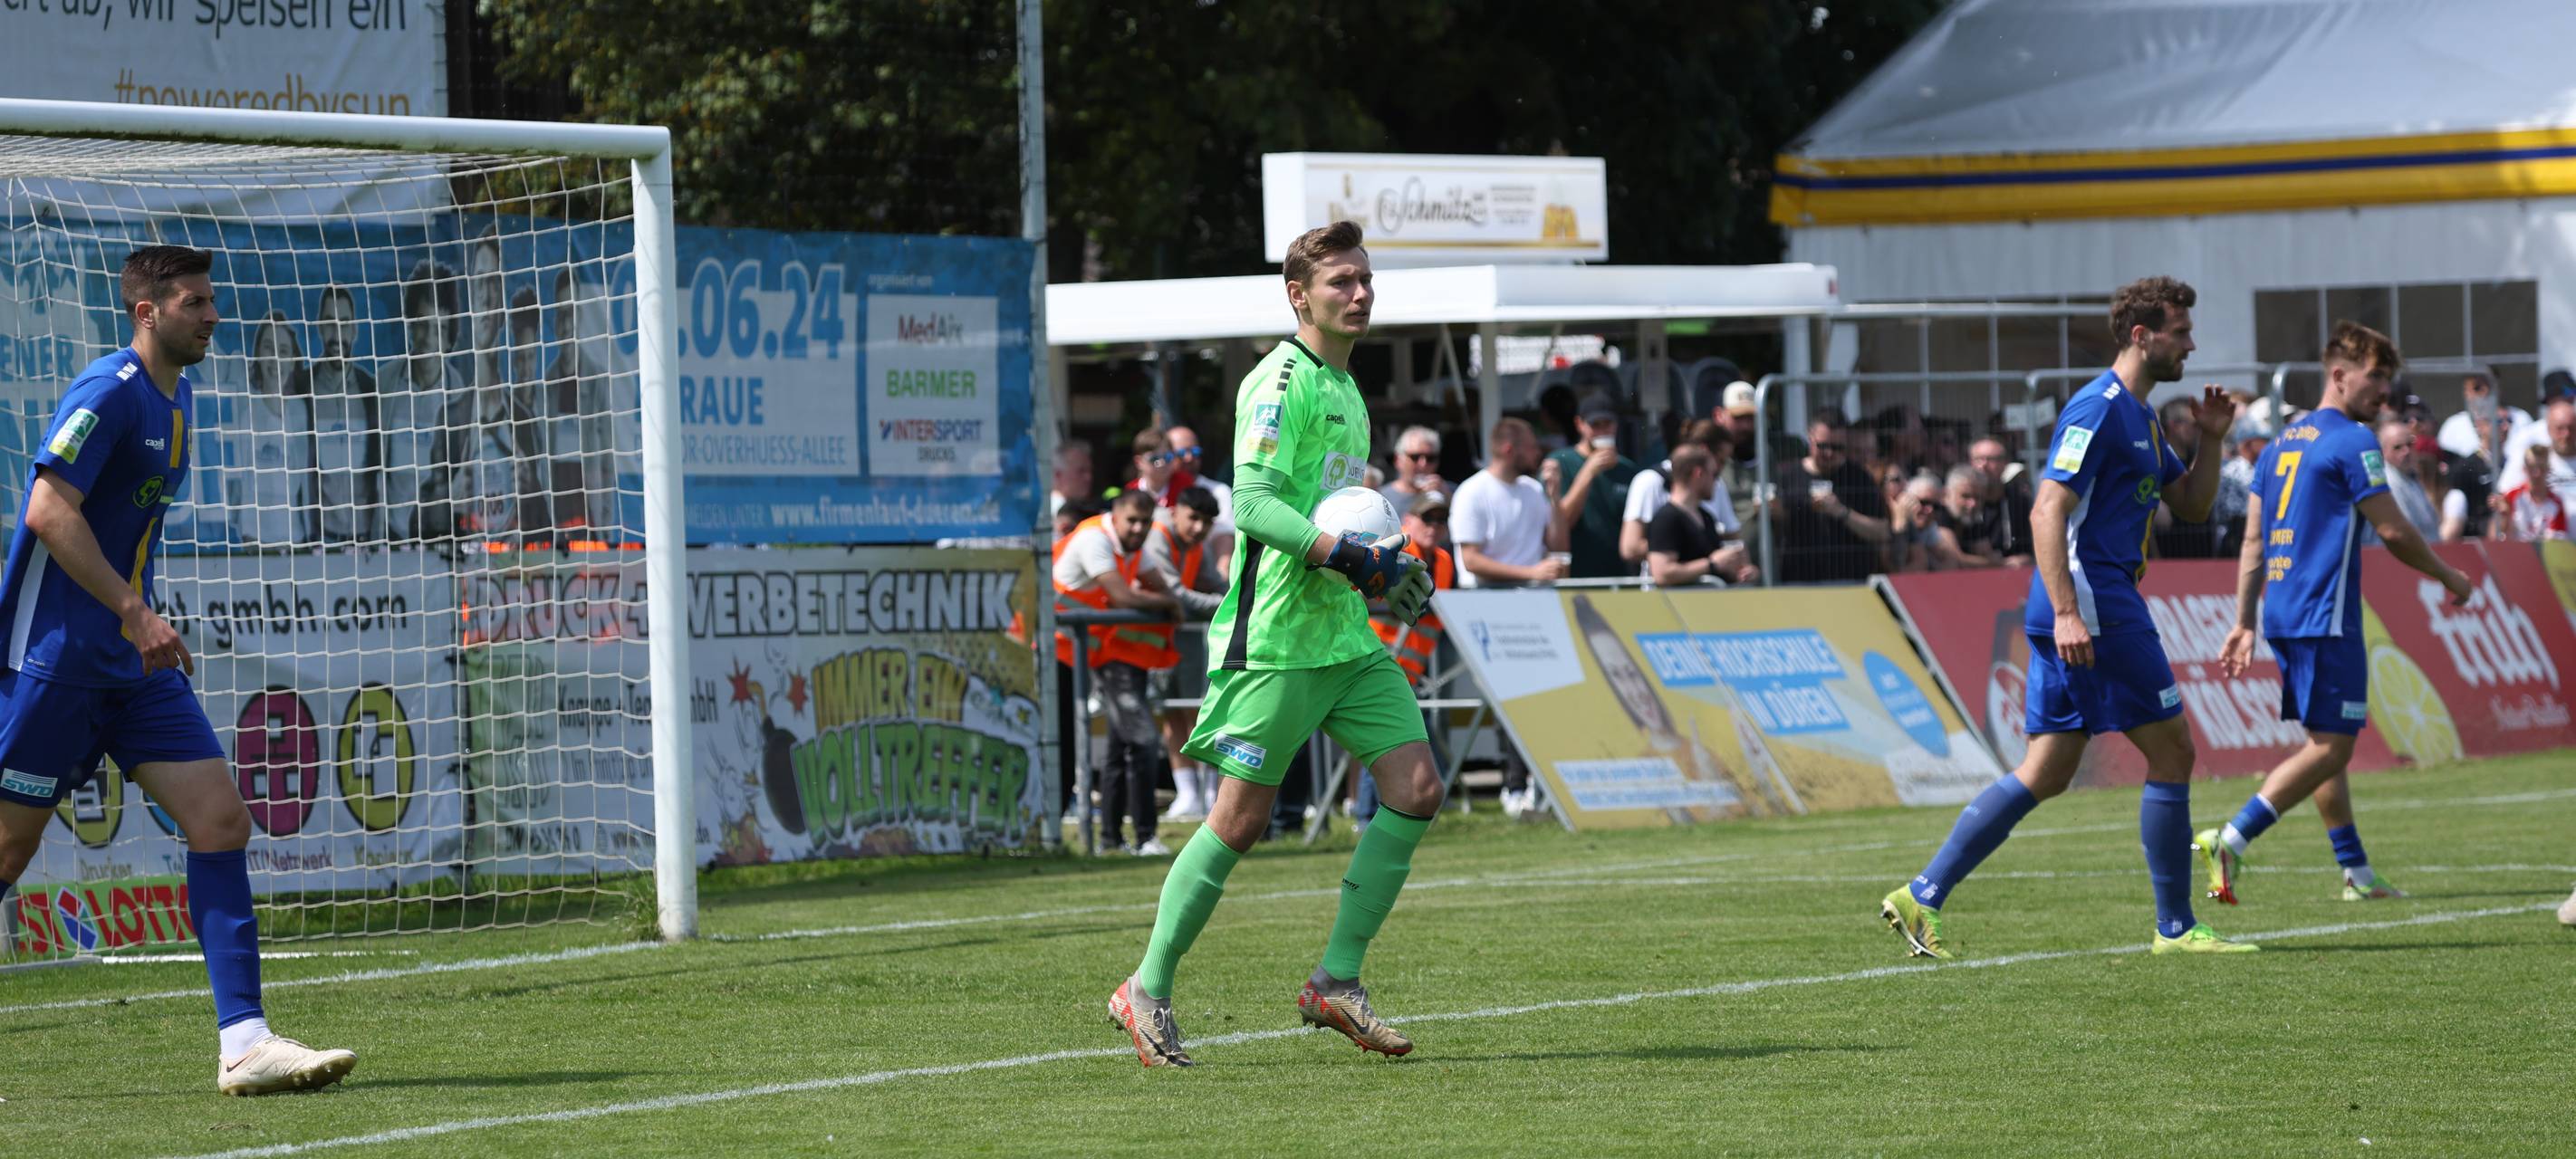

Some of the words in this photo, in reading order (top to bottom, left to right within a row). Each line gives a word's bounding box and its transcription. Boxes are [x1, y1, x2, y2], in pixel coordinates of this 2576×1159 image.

[610, 256, 846, 359] 0.06.24
[887, 369, 977, 398] BARMER
[893, 419, 984, 441] INTERSPORT
[2275, 451, 2303, 521] 7
[2418, 572, 2562, 692] früh
[812, 647, 908, 732] IMMER
[916, 653, 969, 723] EIN
[1762, 680, 1842, 727] DÜREN
[1216, 742, 1263, 767] SWD
[3, 778, 53, 797] SWD
[791, 723, 1029, 849] VOLLTREFFER
